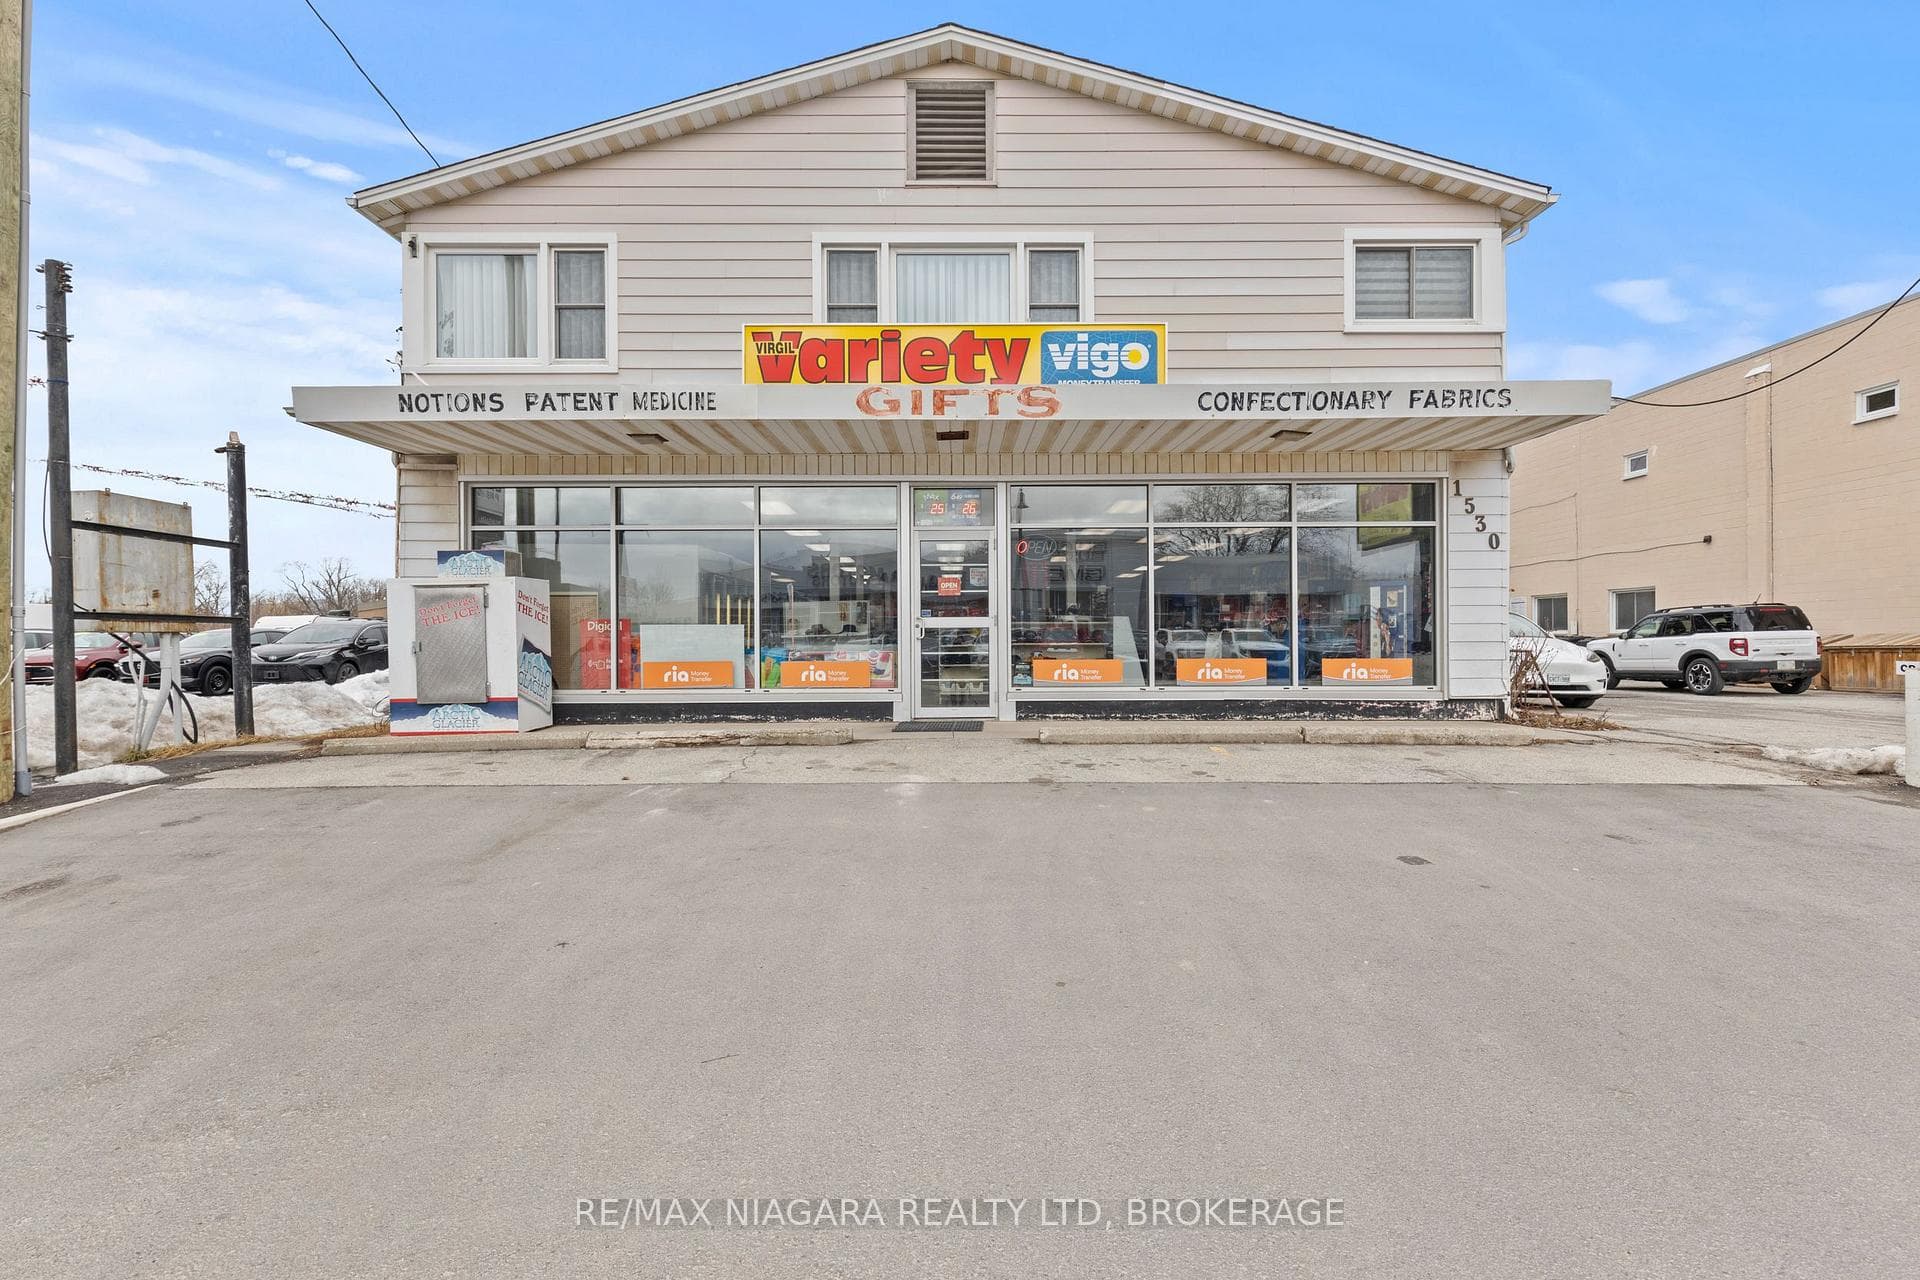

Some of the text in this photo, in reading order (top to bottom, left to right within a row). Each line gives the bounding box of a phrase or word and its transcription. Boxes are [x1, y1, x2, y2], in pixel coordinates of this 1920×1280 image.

[751, 329, 1030, 385] Variety
[756, 342, 795, 354] VIRGIL
[1047, 333, 1150, 378] vigo
[398, 391, 717, 413] NOTIONS PATENT MEDICINE
[856, 386, 1062, 417] GIFTS
[1198, 388, 1512, 412] CONFECTIONARY FABRICS
[1017, 540, 1054, 555] OPEN
[517, 601, 533, 617] THE
[664, 665, 689, 682] ria
[801, 664, 827, 682] ria
[1054, 663, 1079, 680] ria
[1197, 662, 1222, 680] ria
[1343, 662, 1368, 680] ria
[432, 709, 481, 720] ARCTIC
[432, 720, 481, 728] GLACIER
